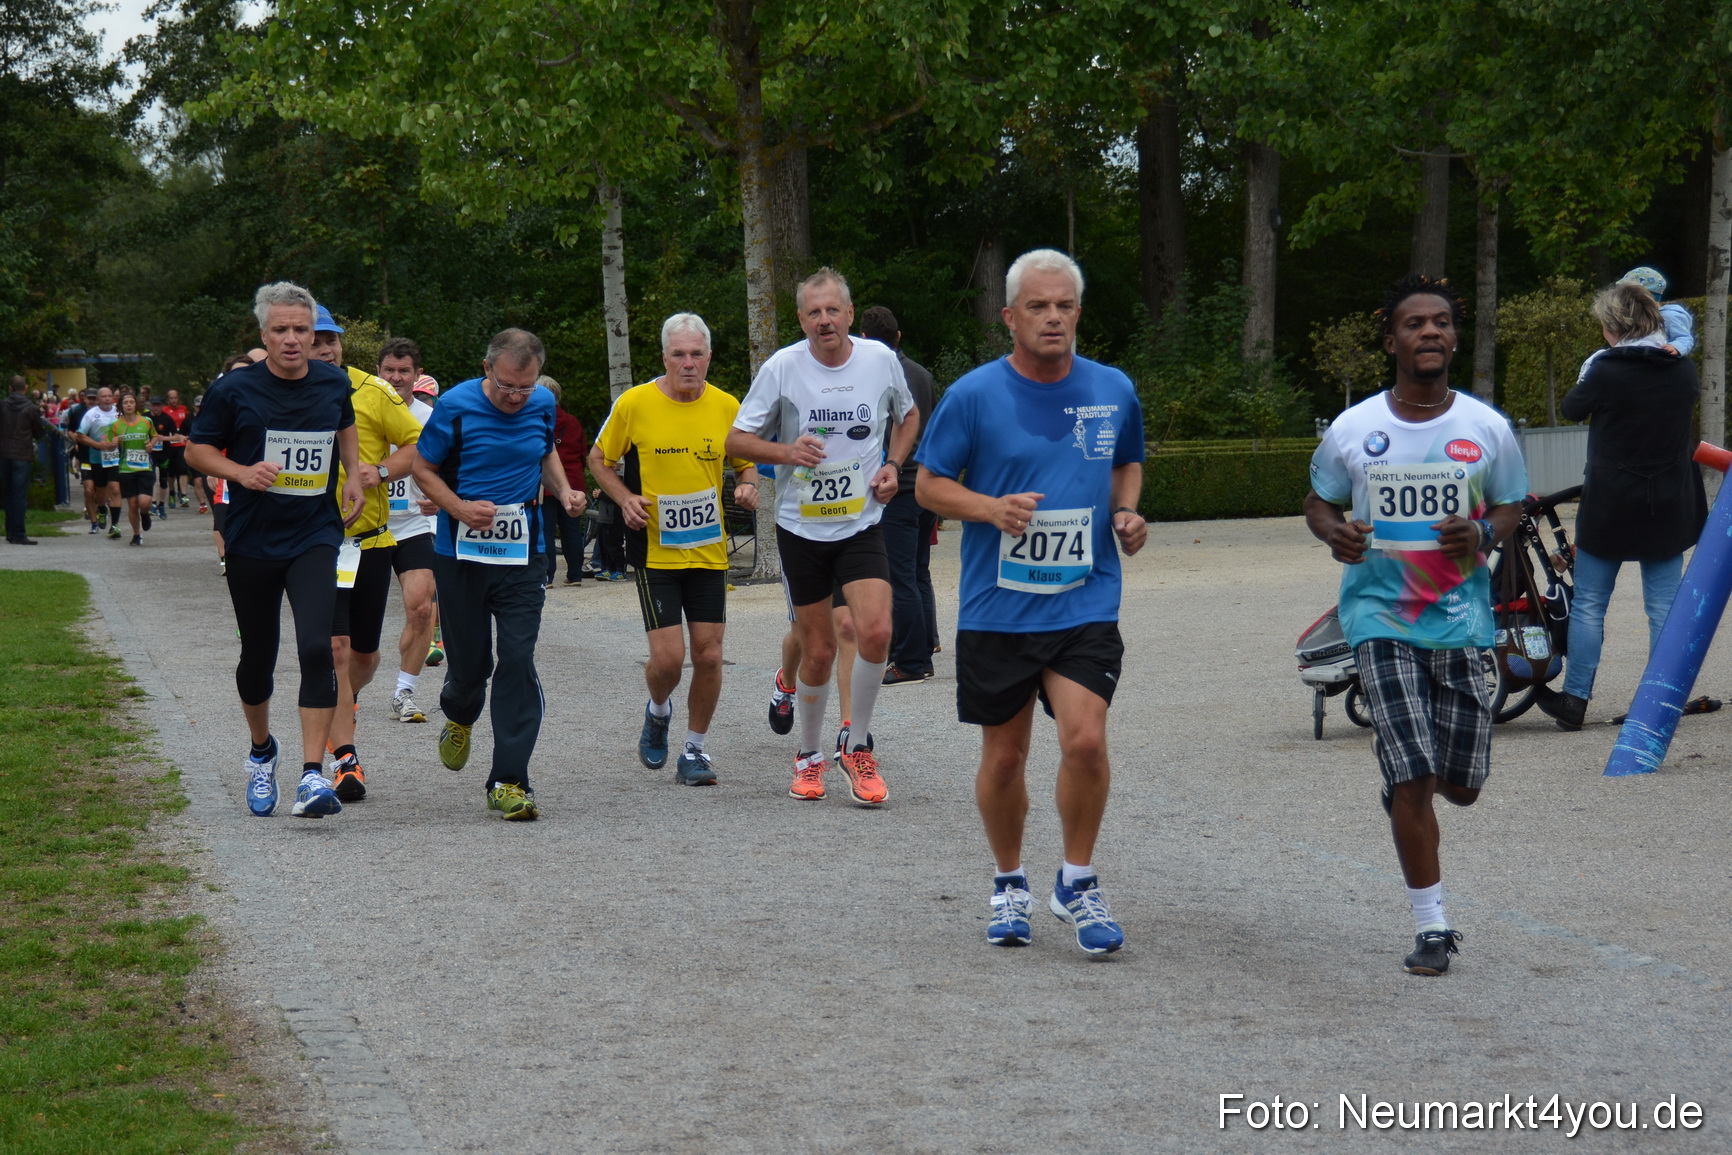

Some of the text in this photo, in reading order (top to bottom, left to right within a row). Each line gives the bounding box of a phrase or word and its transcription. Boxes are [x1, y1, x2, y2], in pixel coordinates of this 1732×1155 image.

[808, 409, 855, 422] Allianz
[1063, 404, 1119, 415] 12. NEUMARKTER
[1076, 411, 1111, 420] STADTLAUF
[268, 436, 326, 446] PARTL Neumarkt
[654, 446, 690, 455] Norbert
[1449, 443, 1480, 458] Hervis
[129, 454, 147, 462] 2747
[280, 447, 323, 472] 195
[819, 465, 851, 477] Neumarkt
[1369, 471, 1451, 482] PARTL Neumarkt
[284, 476, 315, 488] Stefan
[811, 475, 853, 502] 232
[659, 496, 710, 506] PARTL Neumarkt
[1378, 483, 1460, 518] 3088
[665, 502, 716, 530] 3052
[820, 504, 848, 517] Georg
[1036, 519, 1079, 527] Neumarkt
[478, 545, 507, 555] Volker
[1009, 530, 1085, 563] 2074
[1028, 568, 1062, 583] Klaus
